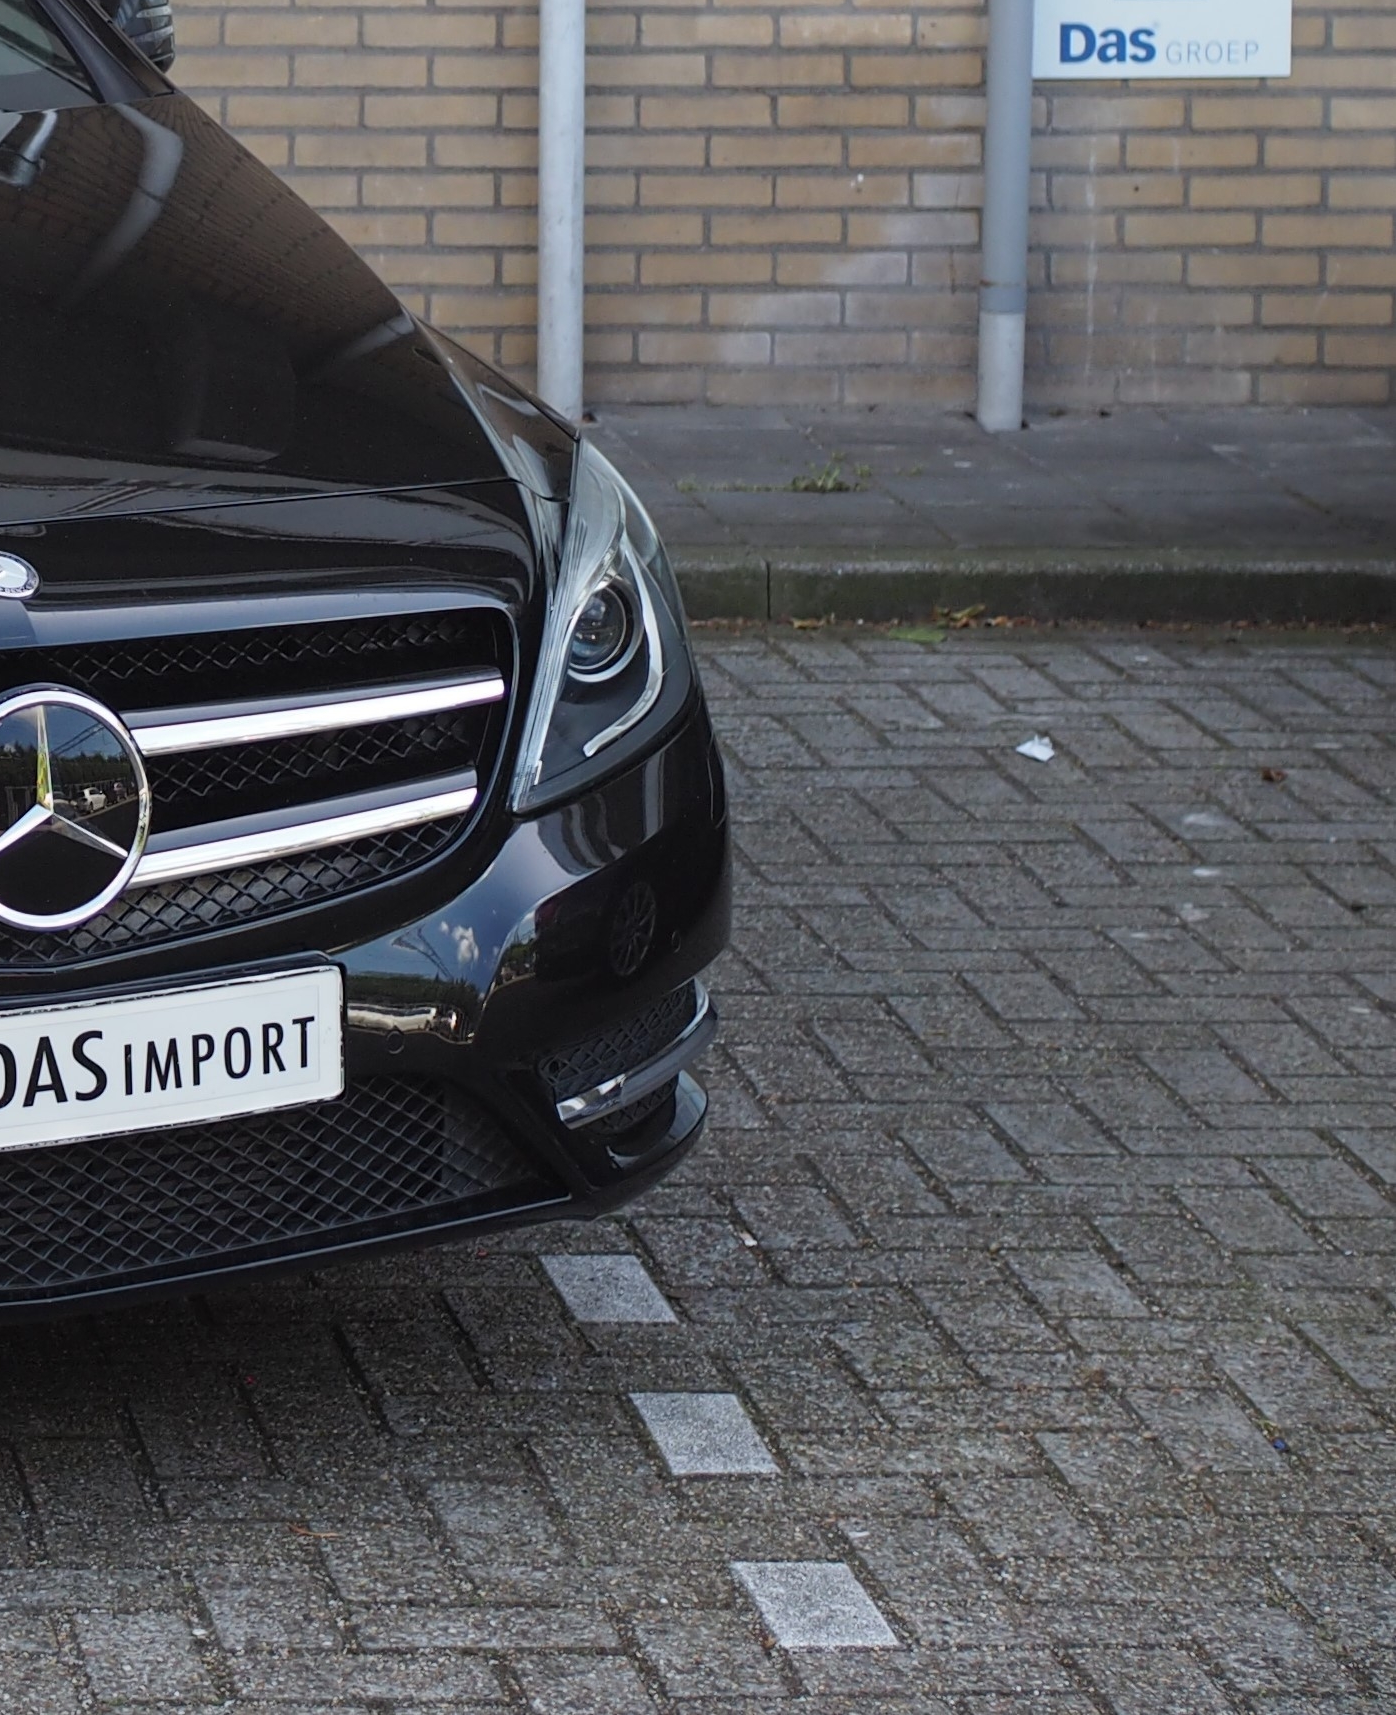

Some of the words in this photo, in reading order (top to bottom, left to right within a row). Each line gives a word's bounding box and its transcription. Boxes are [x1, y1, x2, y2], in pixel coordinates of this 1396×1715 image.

[1059, 22, 1156, 64] Das
[1166, 41, 1259, 66] GROEP
[124, 1016, 316, 1096] IMPORT
